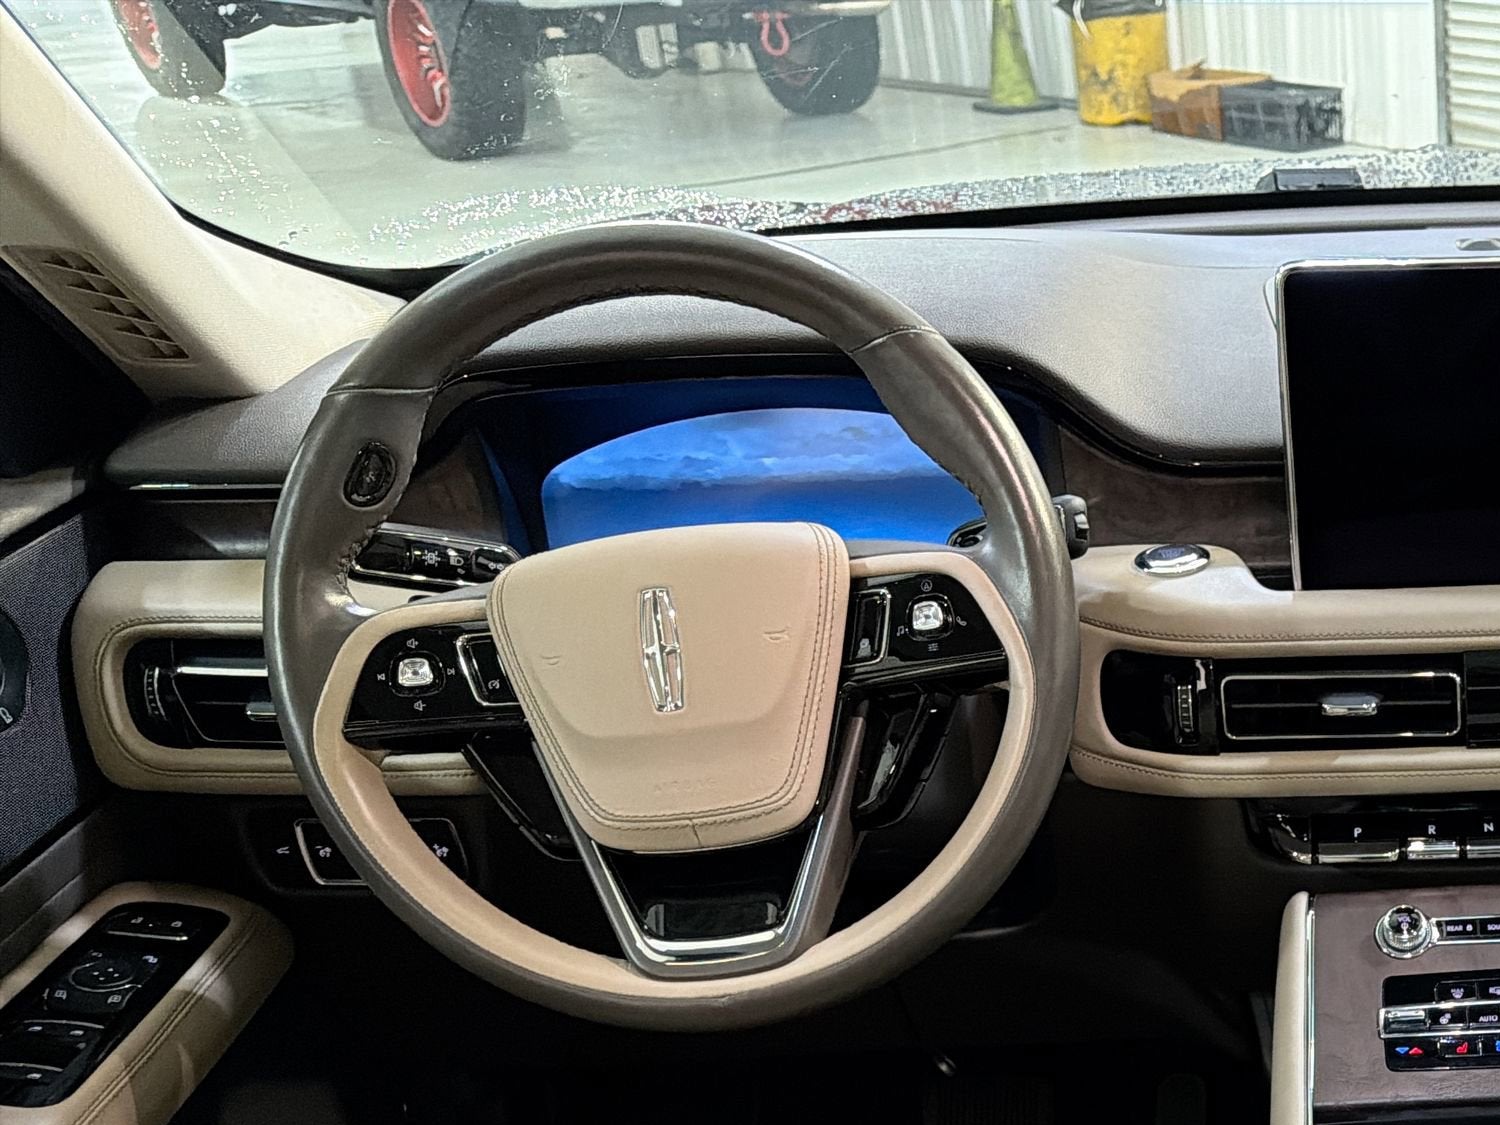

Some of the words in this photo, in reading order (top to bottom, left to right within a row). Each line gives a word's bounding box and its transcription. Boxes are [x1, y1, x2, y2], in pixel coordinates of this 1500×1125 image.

[1428, 824, 1436, 835] R
[1483, 822, 1494, 832] N
[1353, 827, 1362, 838] P
[1479, 1015, 1498, 1023] AUTO
